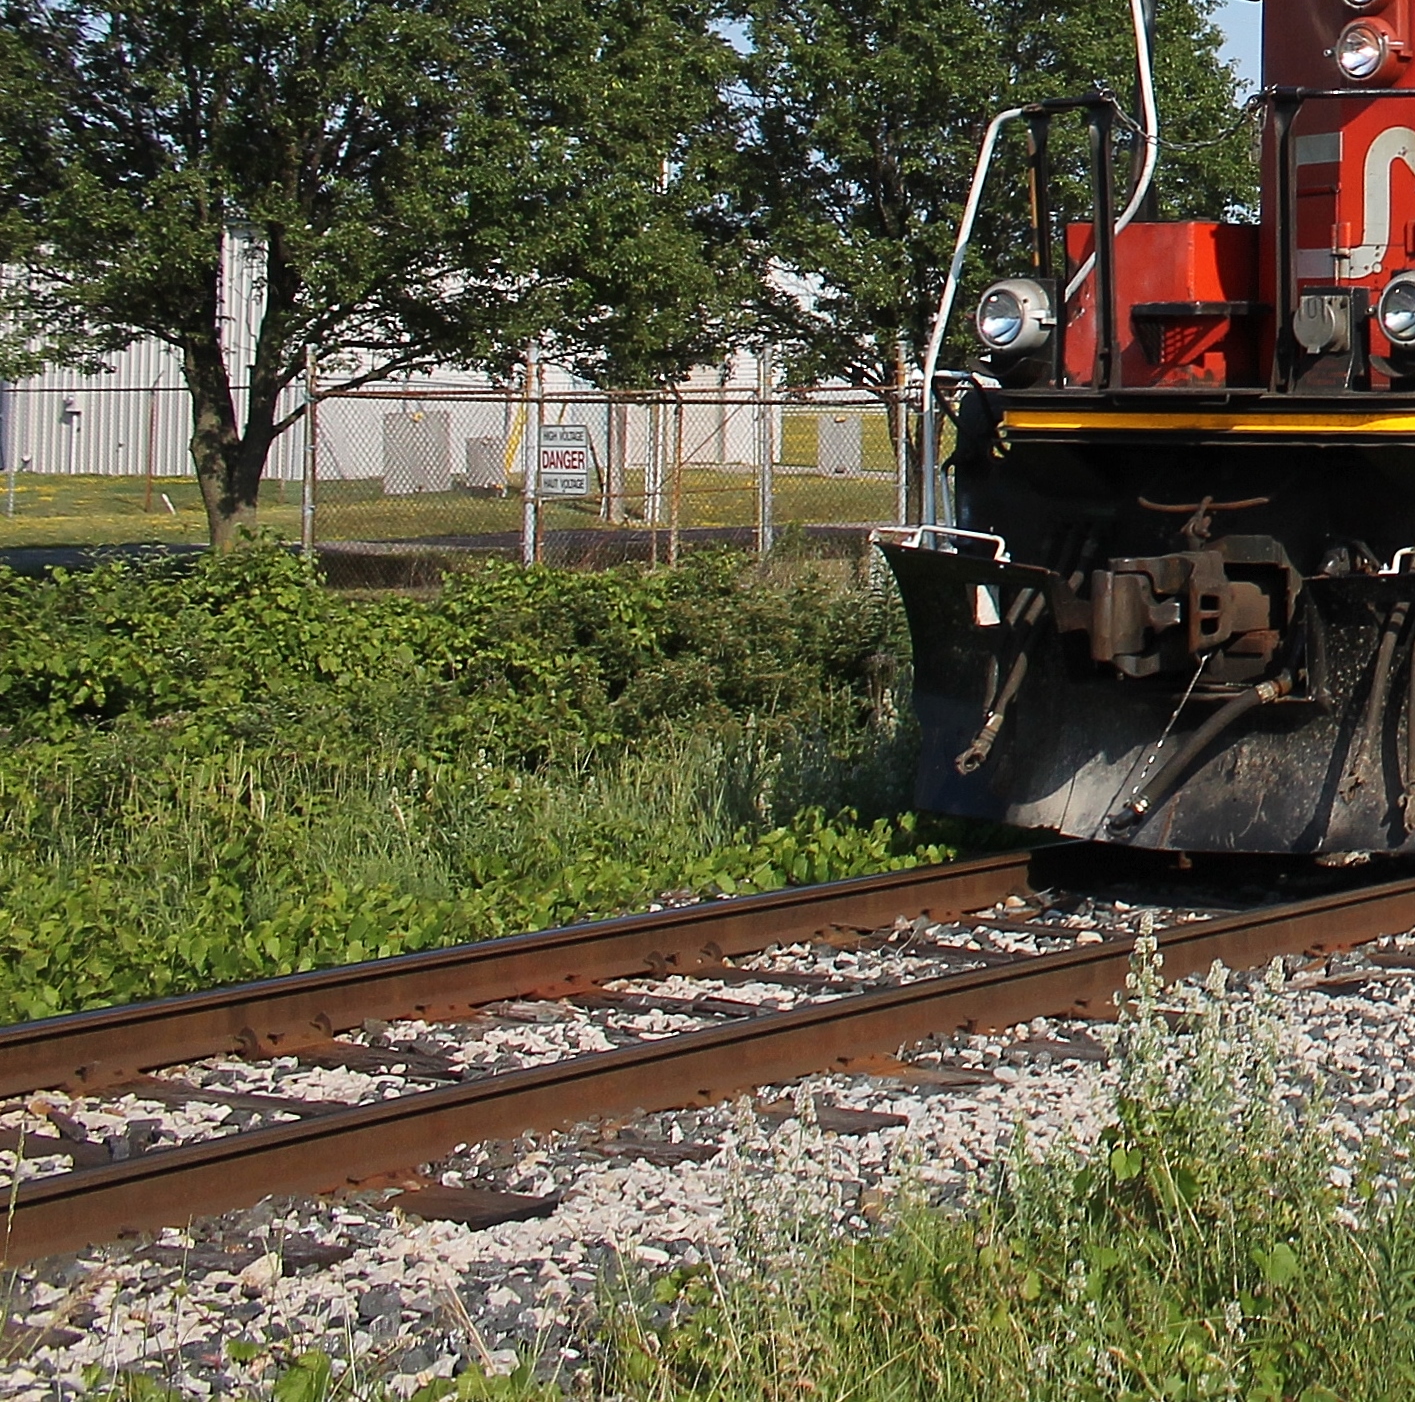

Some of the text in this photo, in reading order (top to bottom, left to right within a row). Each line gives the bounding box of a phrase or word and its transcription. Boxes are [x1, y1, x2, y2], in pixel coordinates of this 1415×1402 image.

[543, 431, 584, 441] HIGH VOLTAGE
[542, 451, 585, 469] DANGER
[560, 478, 584, 489] VOLTAGE
